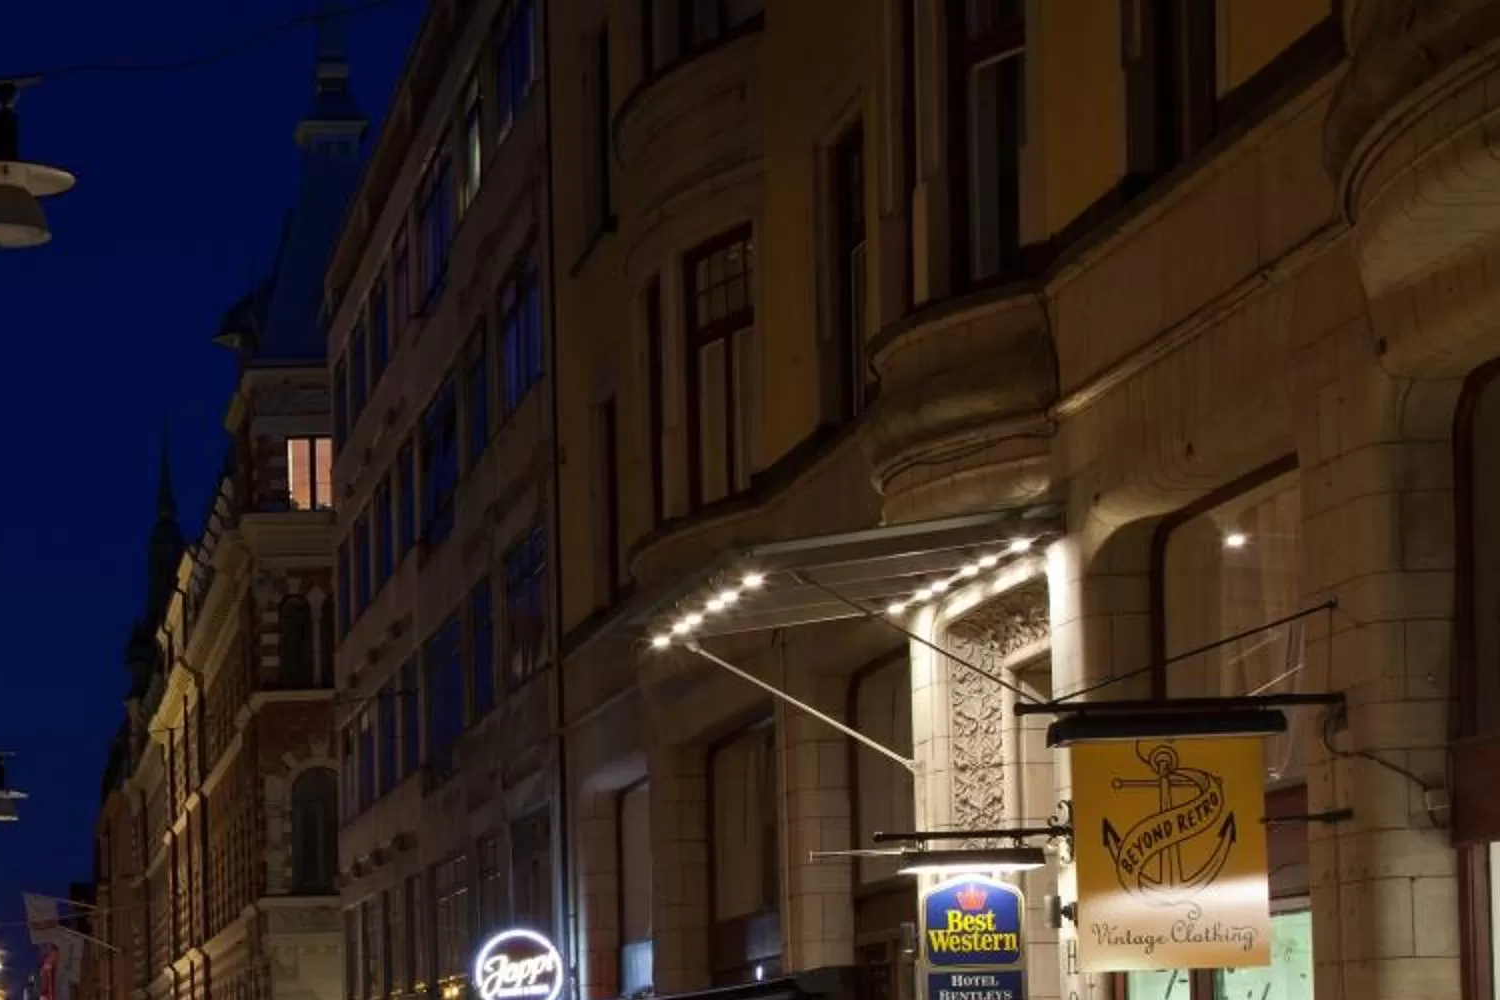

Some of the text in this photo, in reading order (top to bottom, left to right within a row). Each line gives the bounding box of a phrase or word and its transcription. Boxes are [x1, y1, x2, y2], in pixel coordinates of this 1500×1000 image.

[1121, 791, 1219, 875] BEYOND RETRO
[945, 909, 997, 933] Best
[927, 928, 1019, 953] Western
[1091, 919, 1259, 955] Vintage Clothing
[950, 974, 1001, 988] HOTEL
